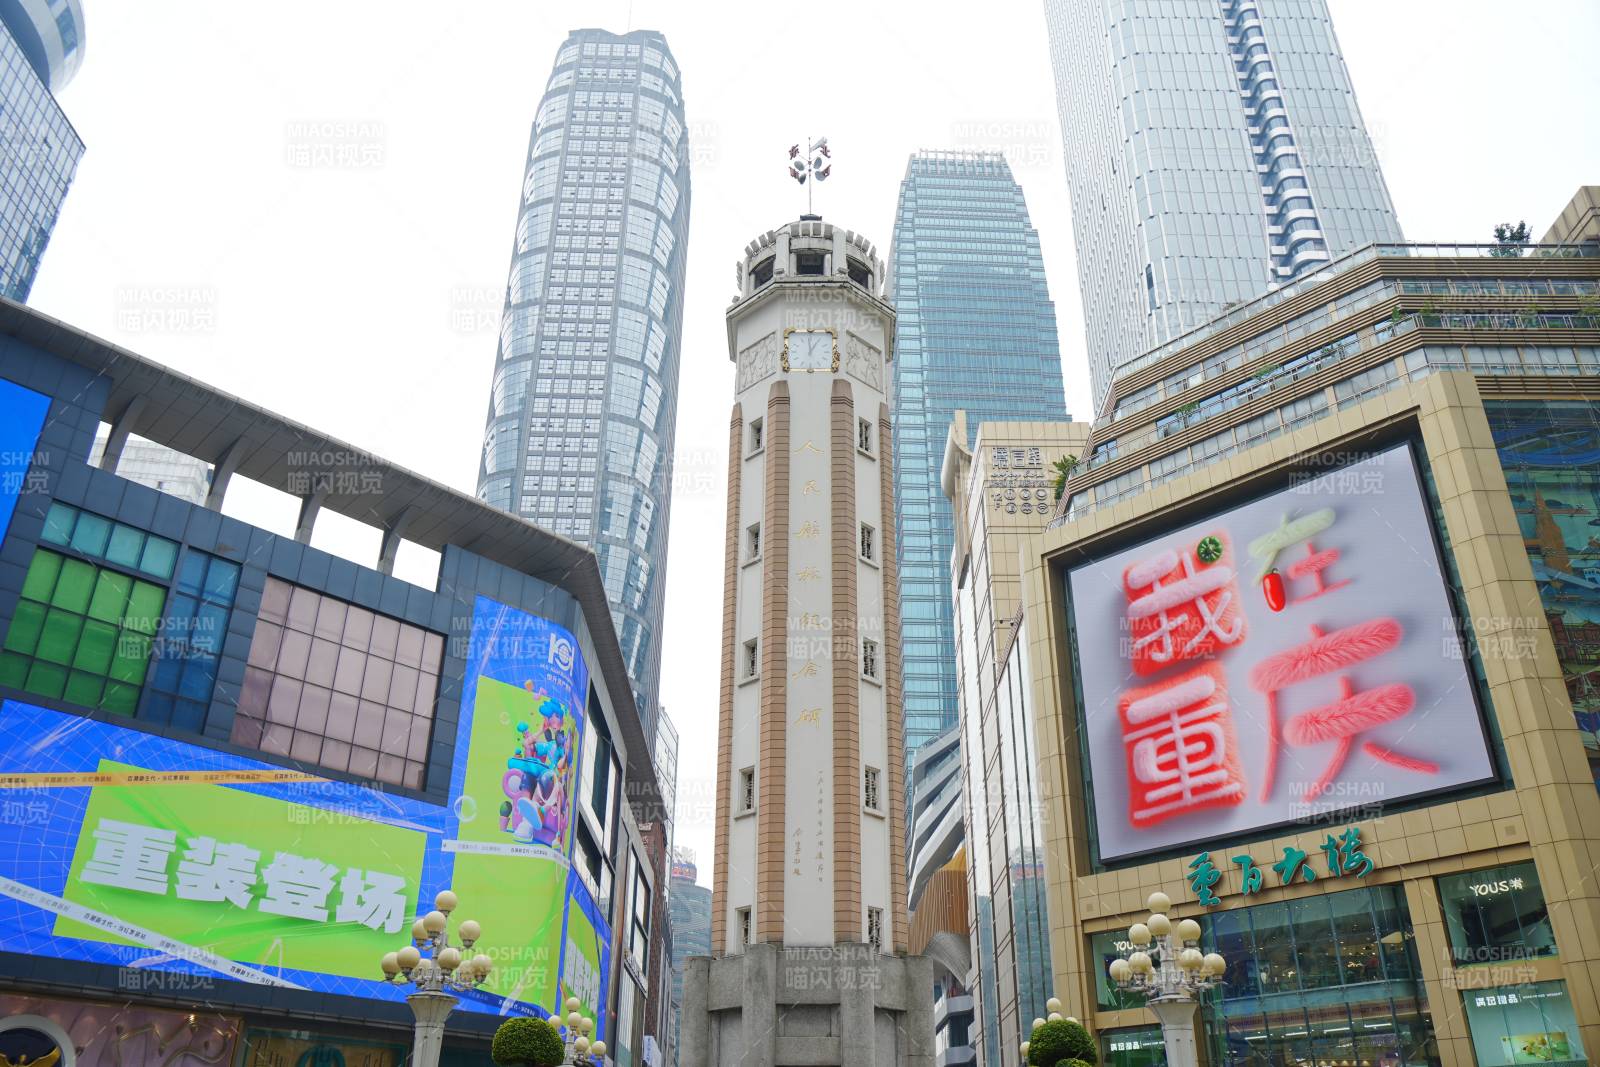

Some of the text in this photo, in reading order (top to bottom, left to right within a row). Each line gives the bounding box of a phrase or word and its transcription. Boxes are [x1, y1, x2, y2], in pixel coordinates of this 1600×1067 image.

[1122, 617, 1439, 822] 重庆
[80, 817, 407, 934] 重装登场
[1186, 827, 1375, 907] 重百大楼
